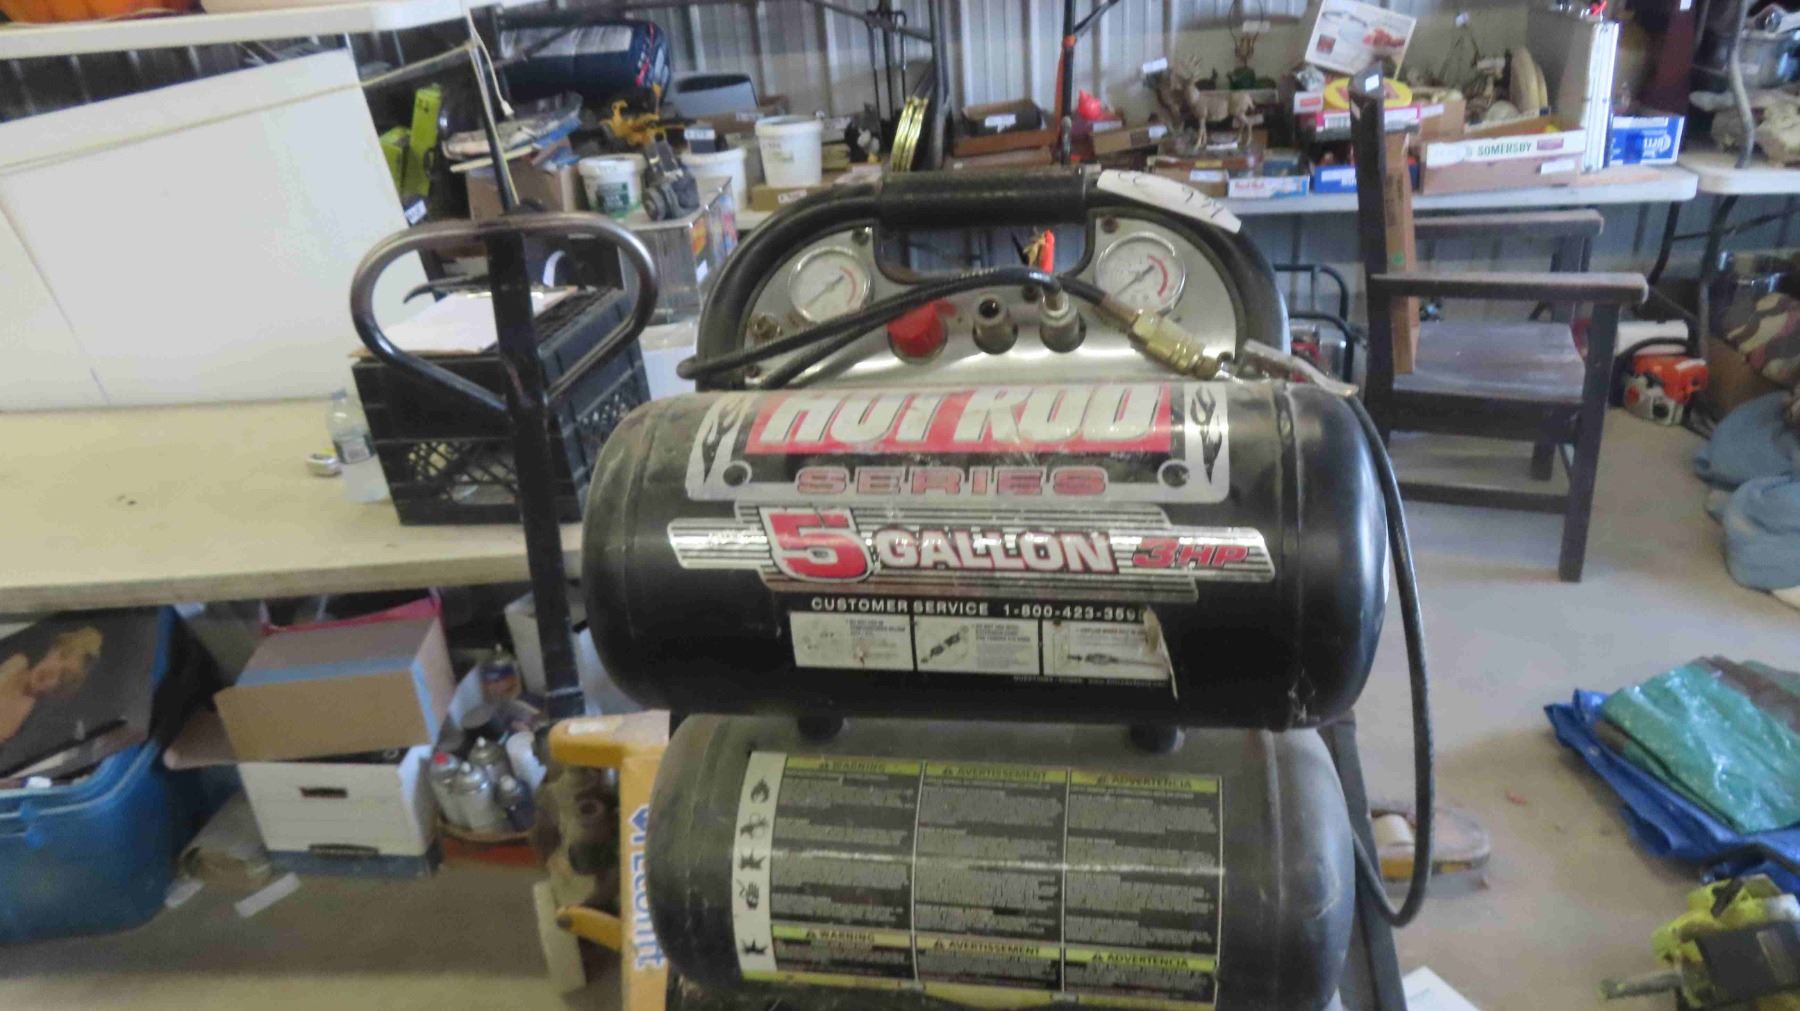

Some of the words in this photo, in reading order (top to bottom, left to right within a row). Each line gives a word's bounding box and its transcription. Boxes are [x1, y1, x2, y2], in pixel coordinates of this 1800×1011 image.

[1477, 141, 1532, 157] SOMERSBY
[760, 391, 946, 442] HOT
[953, 385, 1162, 442] ROD
[796, 465, 1107, 496] SERIES
[761, 507, 871, 581] 5
[872, 527, 1118, 574] GALLON
[1132, 536, 1249, 569] 3HP
[811, 596, 908, 614] CUSTOMER
[913, 599, 989, 616] SERVICE
[1003, 603, 1143, 621] 1-800-423-359
[833, 761, 886, 772] WARNING
[819, 930, 875, 942] WARNING
[948, 940, 1040, 956] AVERTISSEMENT
[1107, 953, 1189, 967] ADVERTENCIA
